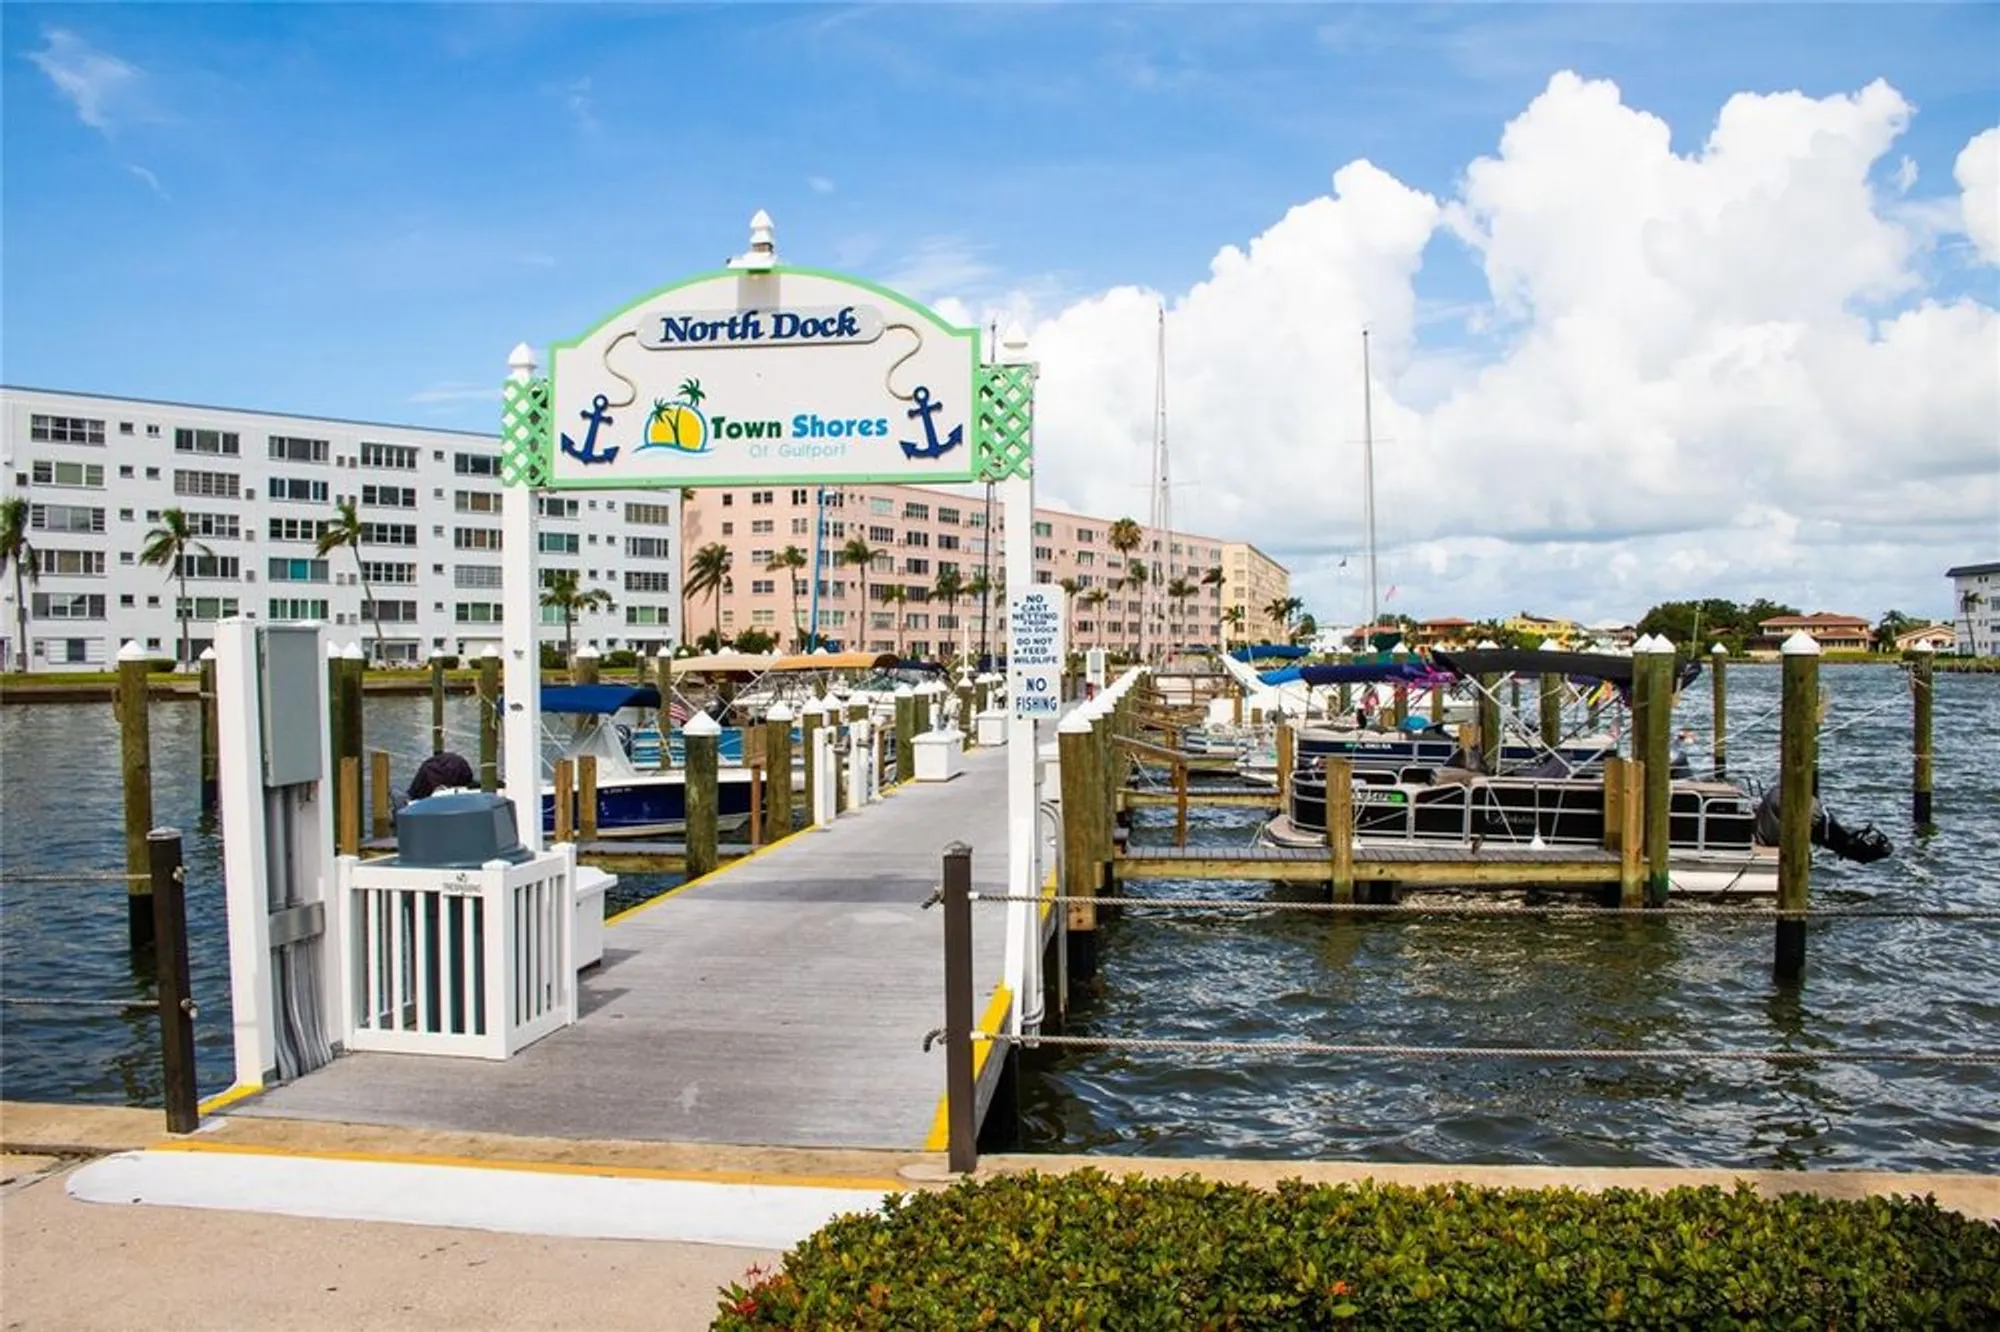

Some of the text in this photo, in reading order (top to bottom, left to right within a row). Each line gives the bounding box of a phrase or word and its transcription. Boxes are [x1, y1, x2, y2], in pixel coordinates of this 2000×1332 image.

[660, 306, 861, 343] North Dock
[711, 413, 889, 439] Town Shores
[749, 442, 848, 461] Of Gulfport
[1026, 594, 1044, 603] NO
[1021, 604, 1048, 612] CAST
[1012, 612, 1058, 621] NETTING
[1016, 637, 1053, 646] DO NOT
[1022, 646, 1048, 655] FEED
[1013, 655, 1058, 665] WILDLIFE
[1026, 677, 1047, 692] NO
[1016, 696, 1057, 712] FISHING
